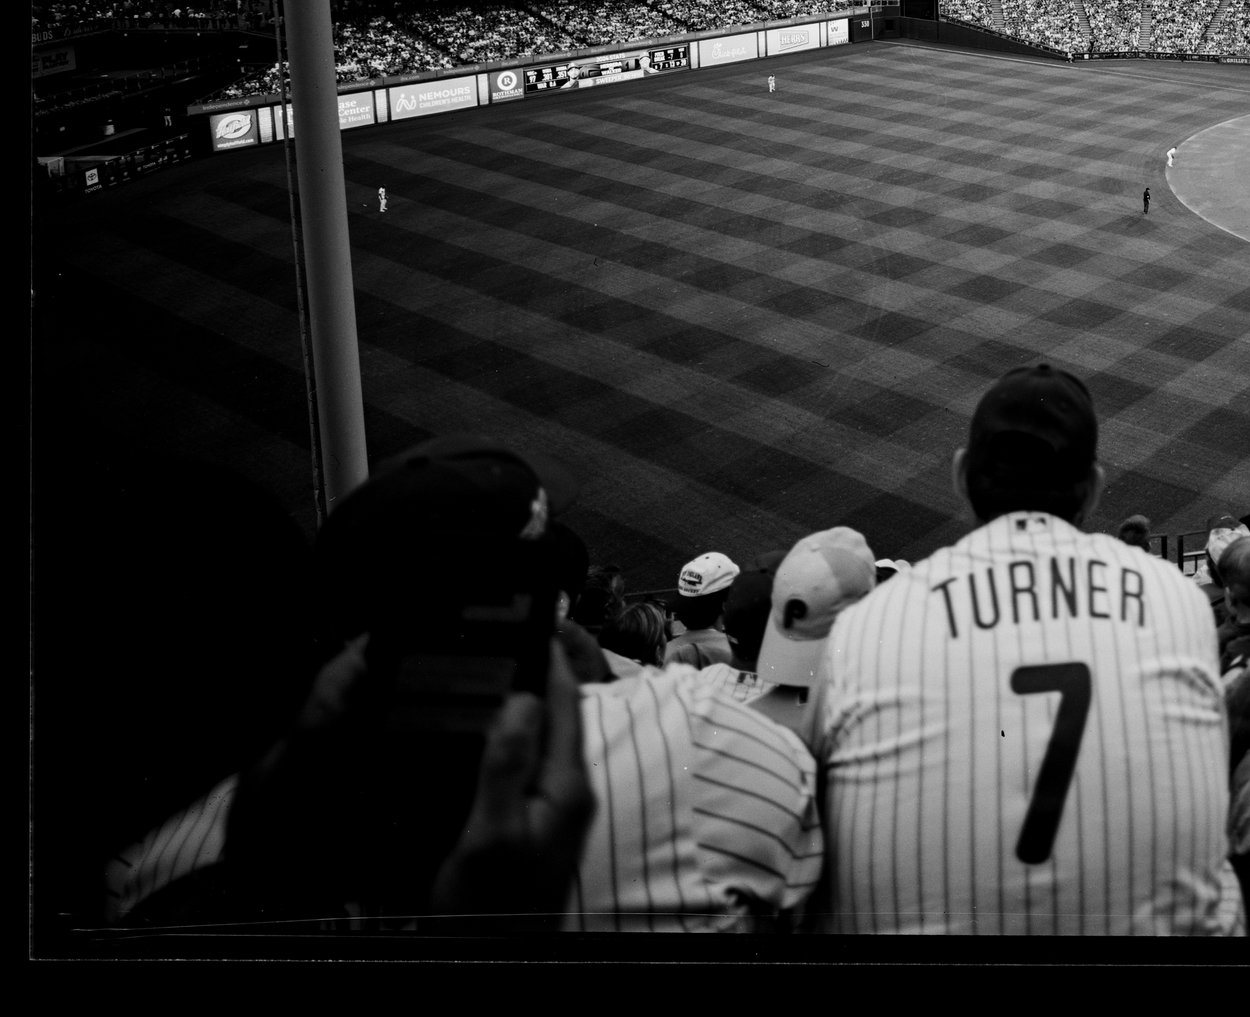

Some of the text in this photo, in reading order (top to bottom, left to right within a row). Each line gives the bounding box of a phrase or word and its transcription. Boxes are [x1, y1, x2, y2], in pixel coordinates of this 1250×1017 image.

[31, 30, 53, 43] BUDS
[419, 86, 471, 101] NEMOURS
[492, 88, 523, 97] ROTHMAN
[202, 101, 243, 110] Independence
[338, 100, 357, 109] ase
[349, 113, 371, 122] Health
[84, 184, 103, 194] TOYOTA
[931, 555, 1146, 639] TURNER
[783, 597, 808, 630] P
[1010, 661, 1092, 865] 7
